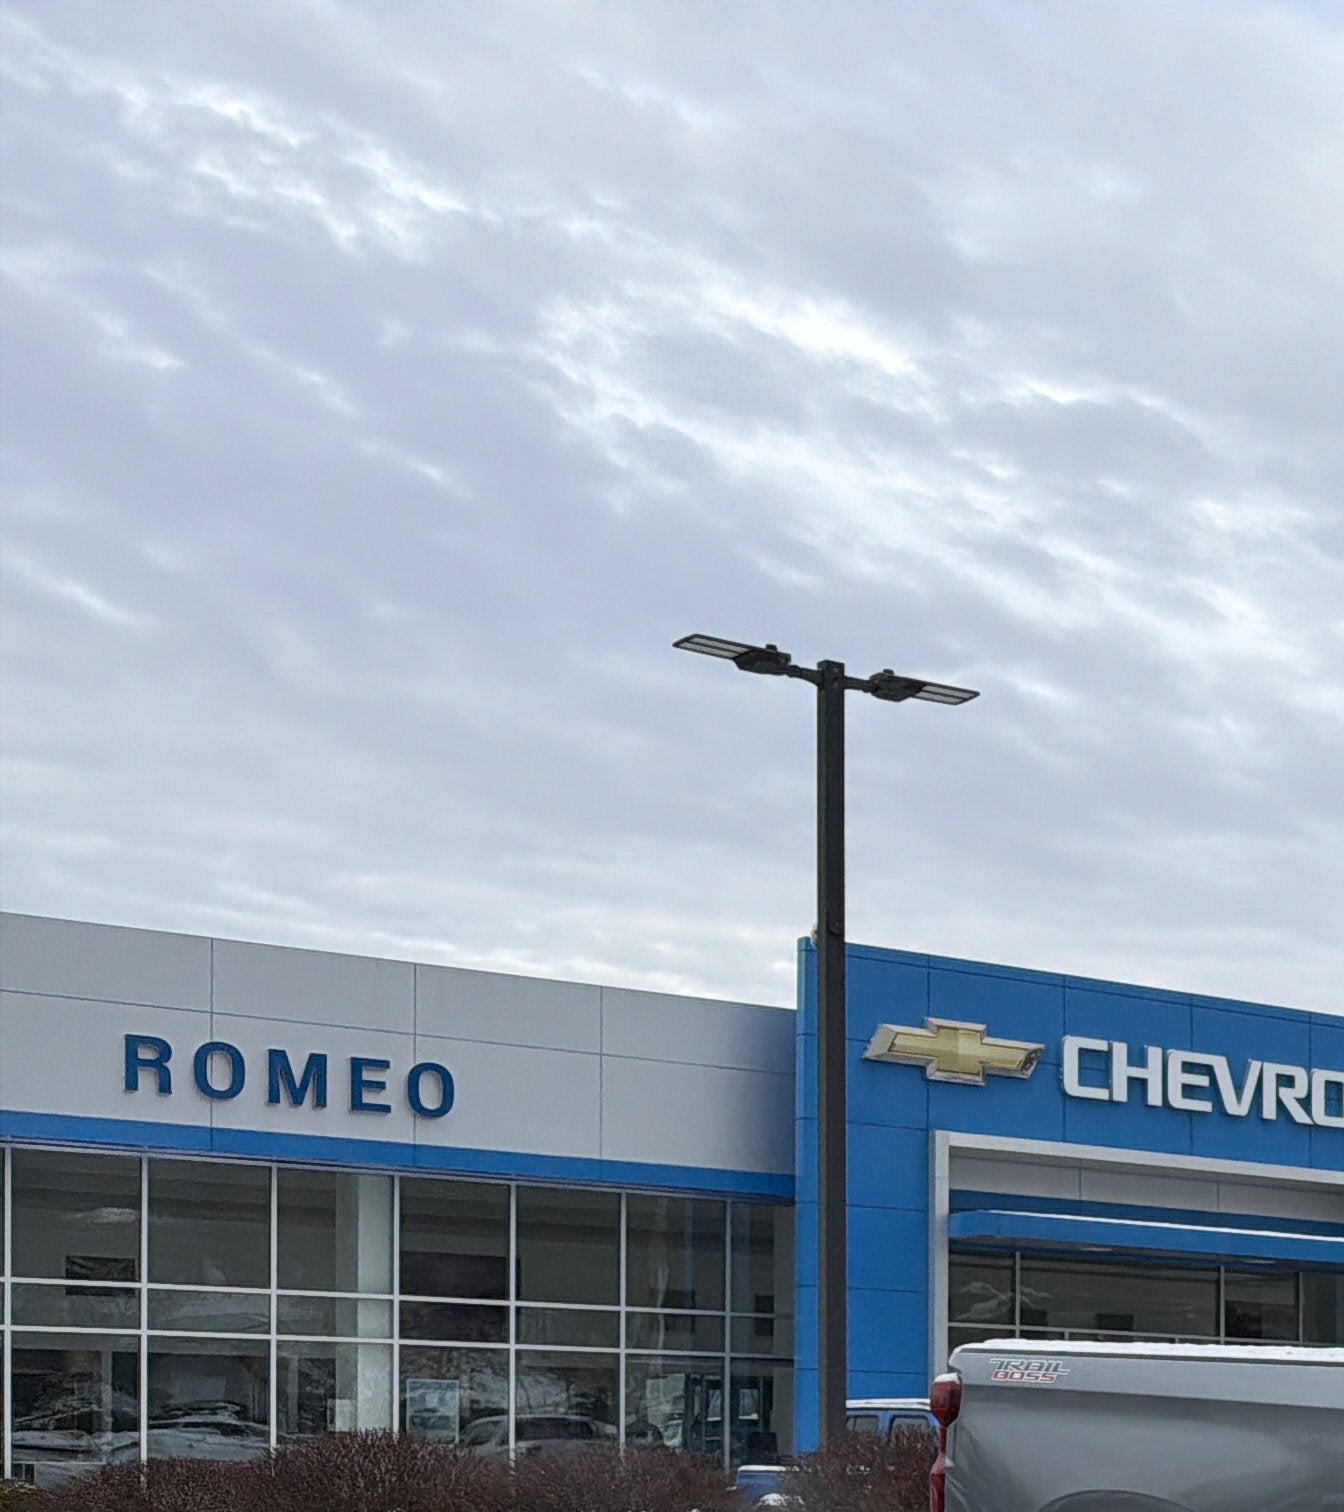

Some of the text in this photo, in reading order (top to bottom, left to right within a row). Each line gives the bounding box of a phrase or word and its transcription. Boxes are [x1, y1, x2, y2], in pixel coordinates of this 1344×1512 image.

[124, 1033, 456, 1119] ROMEO
[990, 1357, 1071, 1376] TRAIL
[991, 1369, 1058, 1384] BOSS
